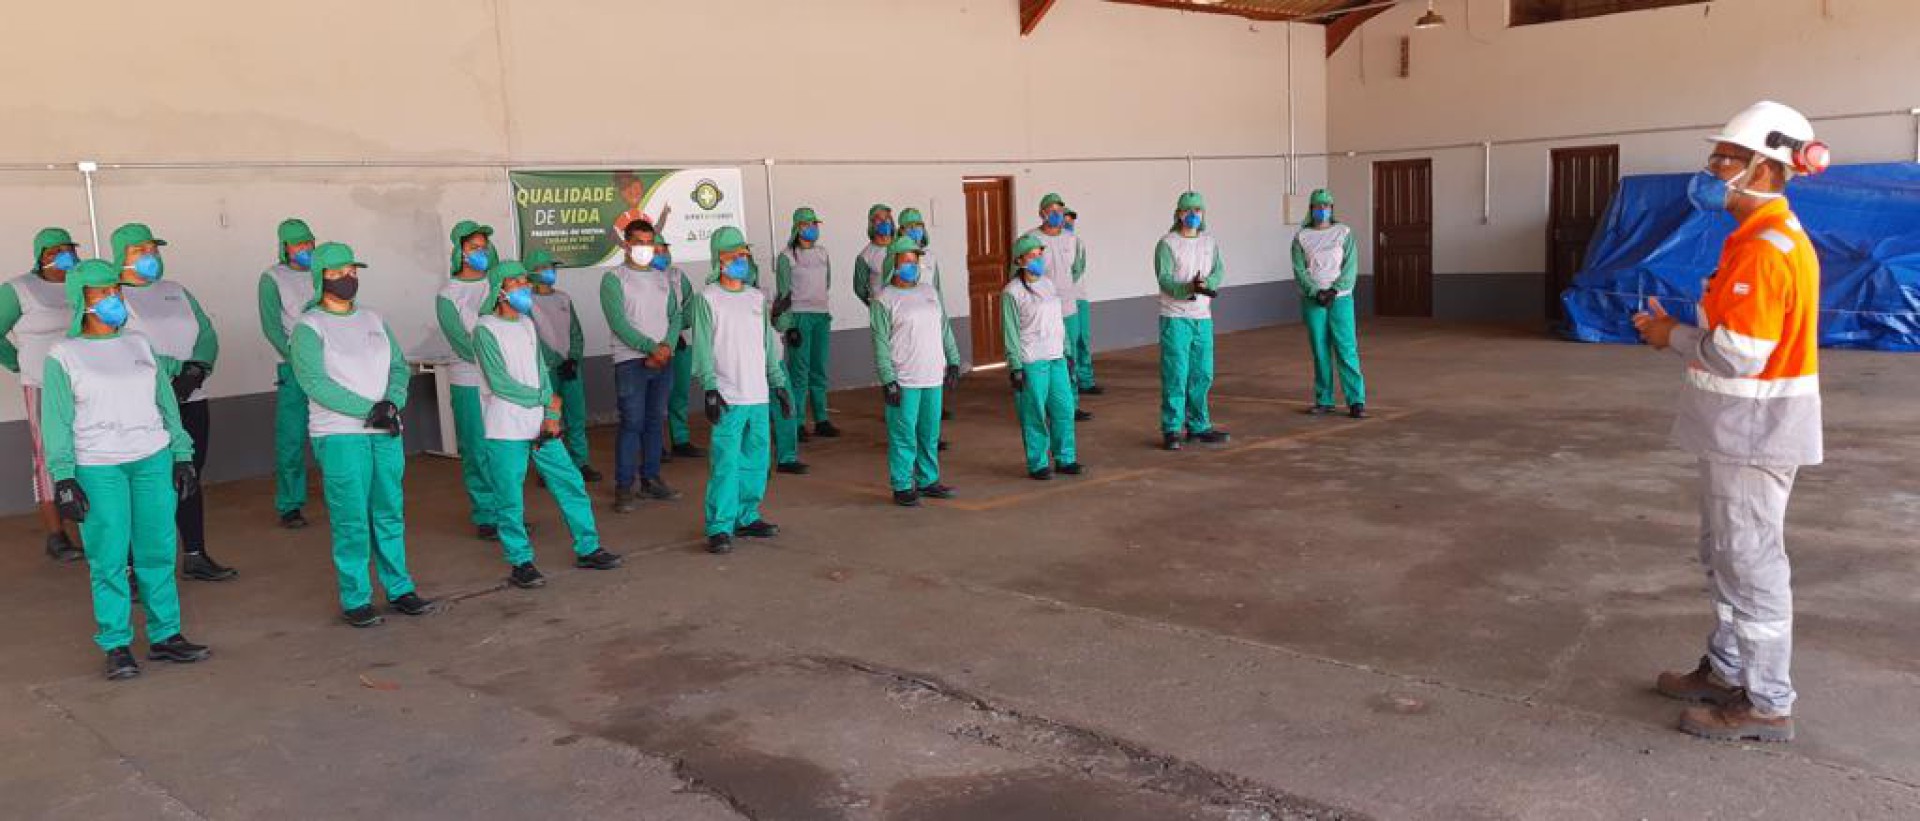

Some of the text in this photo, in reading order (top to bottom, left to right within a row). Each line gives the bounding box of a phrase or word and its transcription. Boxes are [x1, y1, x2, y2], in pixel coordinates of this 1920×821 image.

[517, 187, 614, 208] QUALIDADE
[535, 207, 600, 225] DE VIDA
